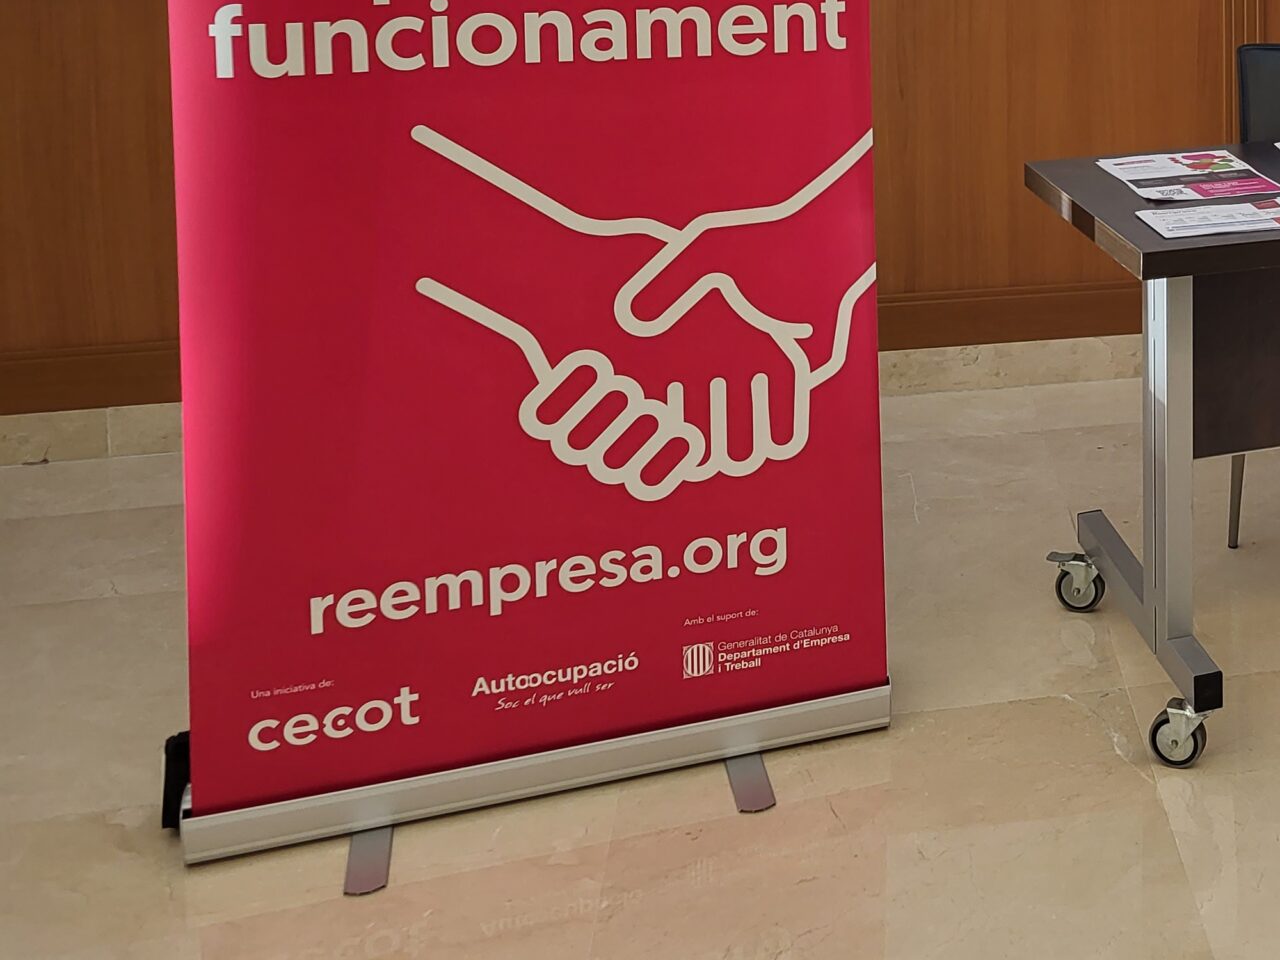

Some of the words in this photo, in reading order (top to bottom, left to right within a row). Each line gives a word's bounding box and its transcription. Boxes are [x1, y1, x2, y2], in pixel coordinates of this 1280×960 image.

[309, 526, 788, 635] reempresa.org
[683, 617, 705, 627] Amb
[706, 615, 715, 623] el
[716, 612, 744, 622] suport
[745, 608, 760, 617] de:
[717, 634, 773, 652] Generalitat
[774, 632, 788, 641] de
[789, 624, 839, 642] Catalunya
[718, 643, 791, 662] Departament
[792, 633, 850, 650] d'Empresa
[471, 651, 640, 697] Autoocupació
[718, 664, 722, 673] i
[725, 658, 761, 672] Treball
[250, 689, 271, 699] Una
[273, 683, 316, 696] iniciativa
[318, 679, 335, 688] de:
[494, 698, 520, 711] Soc
[523, 693, 536, 706] el
[538, 692, 564, 707] que
[567, 682, 592, 697] vull
[595, 680, 616, 692] ser
[247, 686, 420, 751] cecot
